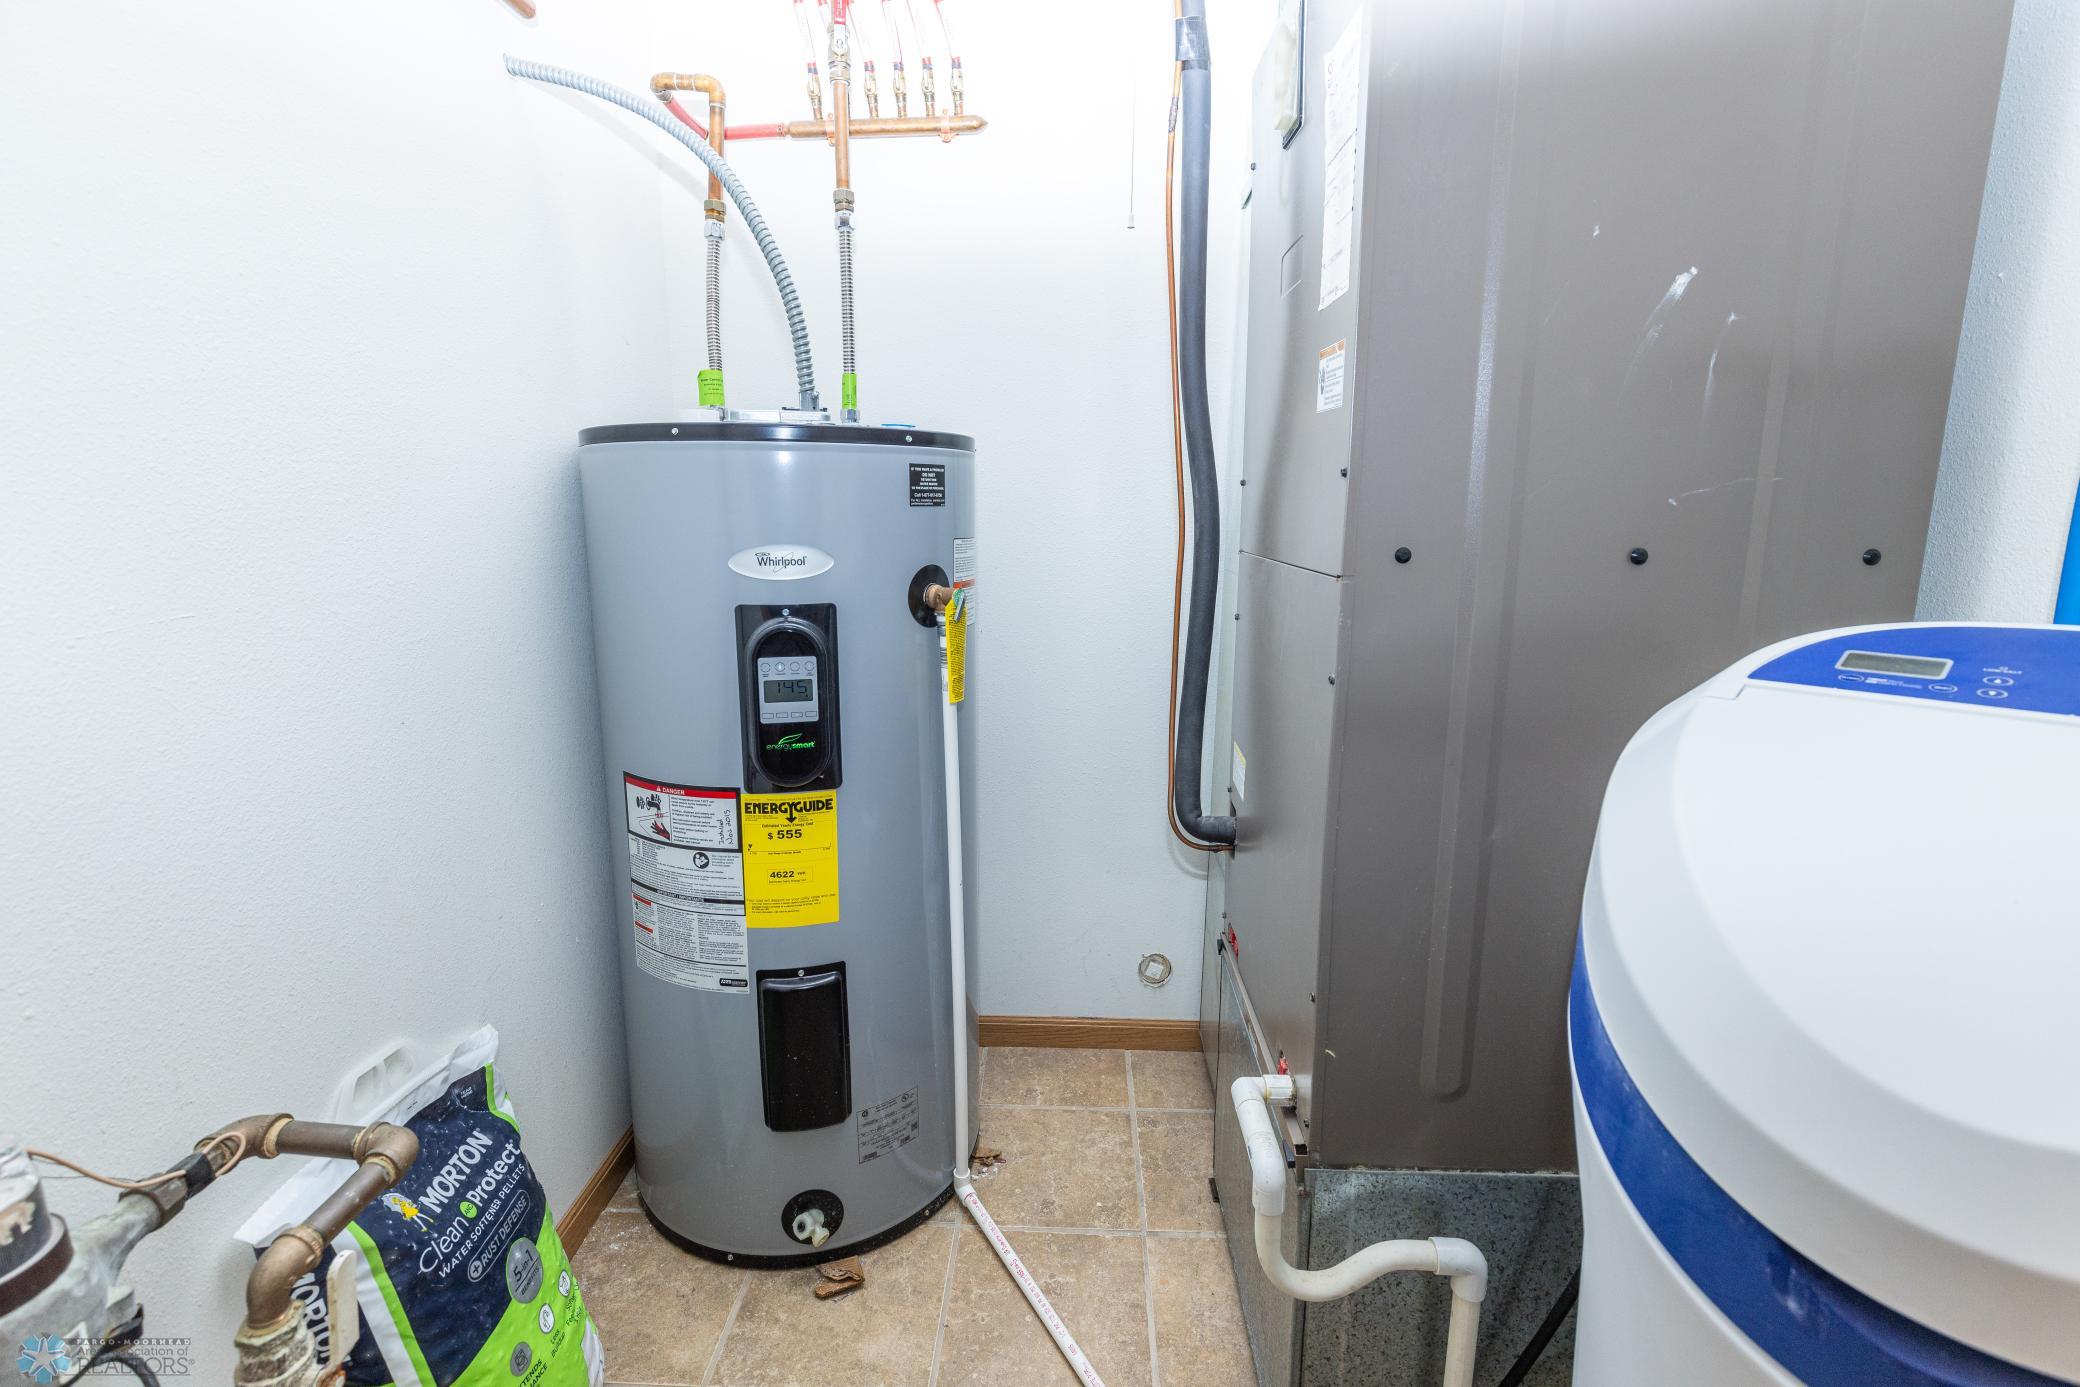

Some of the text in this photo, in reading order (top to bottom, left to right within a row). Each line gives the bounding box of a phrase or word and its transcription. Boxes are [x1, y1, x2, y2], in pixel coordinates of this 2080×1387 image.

[757, 556, 806, 568] Whirlpool
[777, 681, 807, 694] 145
[662, 787, 685, 795] DANGER
[744, 798, 833, 814] ENERGYGUIDE
[723, 809, 731, 827] 2015
[768, 829, 802, 840] $ 555
[419, 1130, 493, 1213] MORTON
[418, 1141, 520, 1273] Clean AND Protect
[438, 1164, 525, 1279] WATER SOFTENER PELLETS
[481, 1195, 527, 1267] RUST DEFENSE
[513, 1249, 534, 1282] 5-in-1
[520, 1358, 542, 1387] TENDS
